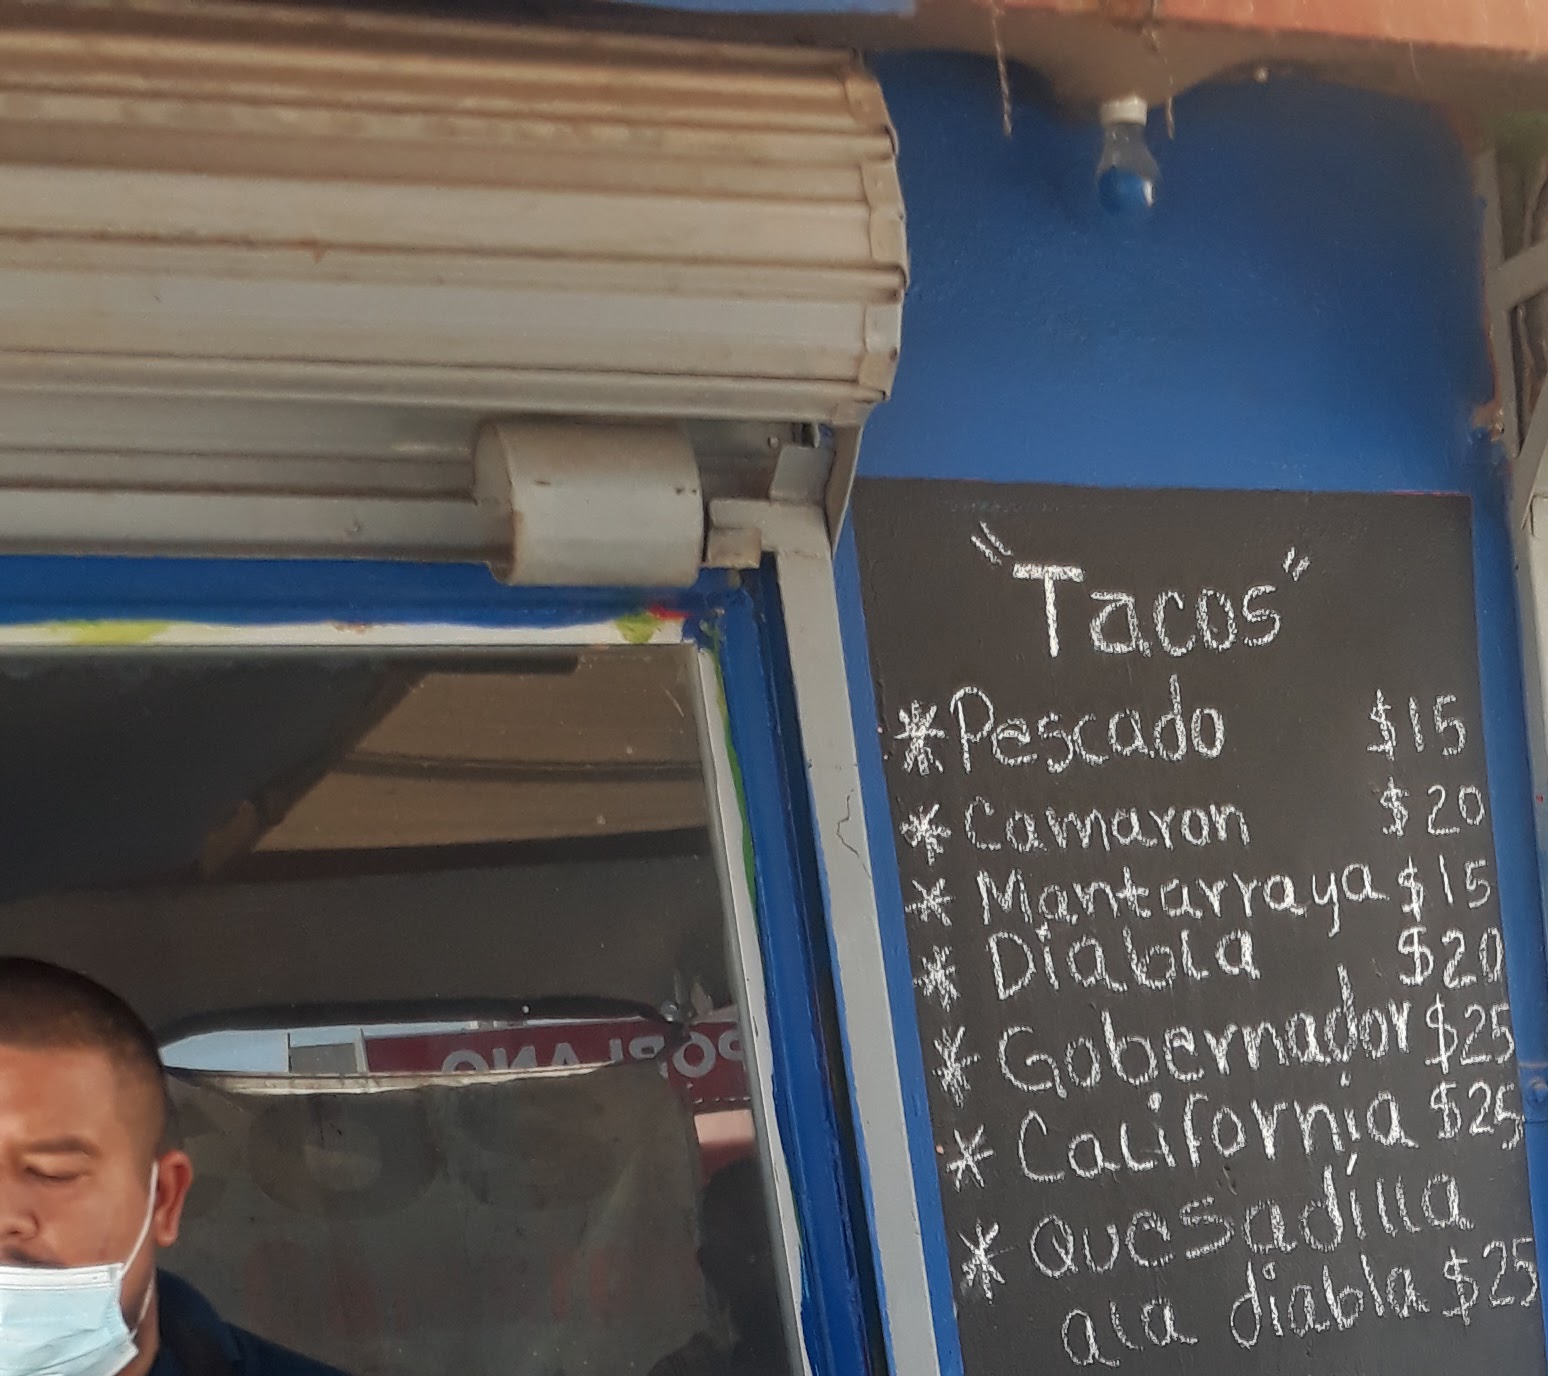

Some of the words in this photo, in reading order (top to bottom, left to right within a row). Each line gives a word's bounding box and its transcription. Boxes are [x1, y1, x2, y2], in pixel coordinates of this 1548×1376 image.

[949, 675, 1226, 774] Pescado
[1368, 689, 1467, 760] $15
[964, 795, 1252, 853] Camaron
[1379, 777, 1486, 837] $20
[975, 862, 1390, 938] Mantarraya
[1398, 855, 1492, 924] $15
[985, 922, 1260, 1001] Diabla
[1398, 925, 1503, 988] $20
[998, 966, 1412, 1099] Gobernador
[1425, 993, 1516, 1074] $25
[1017, 1072, 1420, 1183] California
[1430, 1079, 1524, 1150] $25
[1029, 1152, 1475, 1279] Quesadilla
[1229, 1253, 1431, 1349] diabla
[1442, 1237, 1539, 1326] $25
